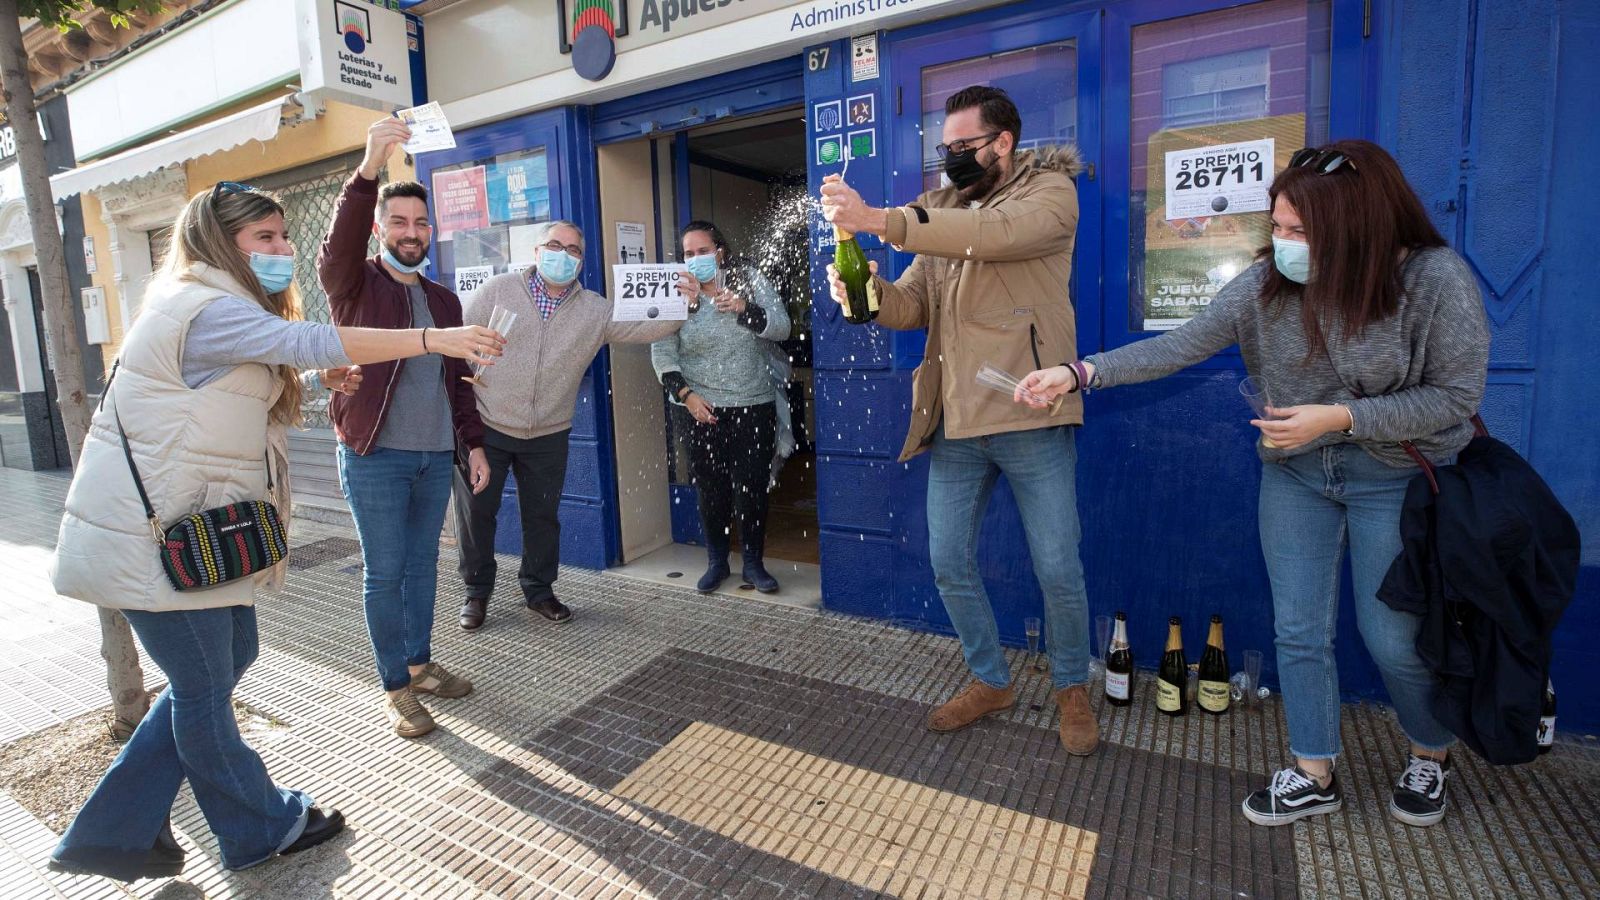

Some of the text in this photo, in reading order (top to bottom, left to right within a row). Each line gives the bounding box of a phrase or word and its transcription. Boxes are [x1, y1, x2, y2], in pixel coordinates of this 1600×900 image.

[377, 63, 383, 72] y
[808, 48, 829, 71] 67
[340, 63, 397, 85] Apuestas del
[340, 74, 373, 89] Estado
[1195, 151, 1260, 169] PREMIO
[1175, 162, 1263, 191] 26711
[465, 271, 489, 279] PREMIO
[636, 272, 680, 282] PREMIO
